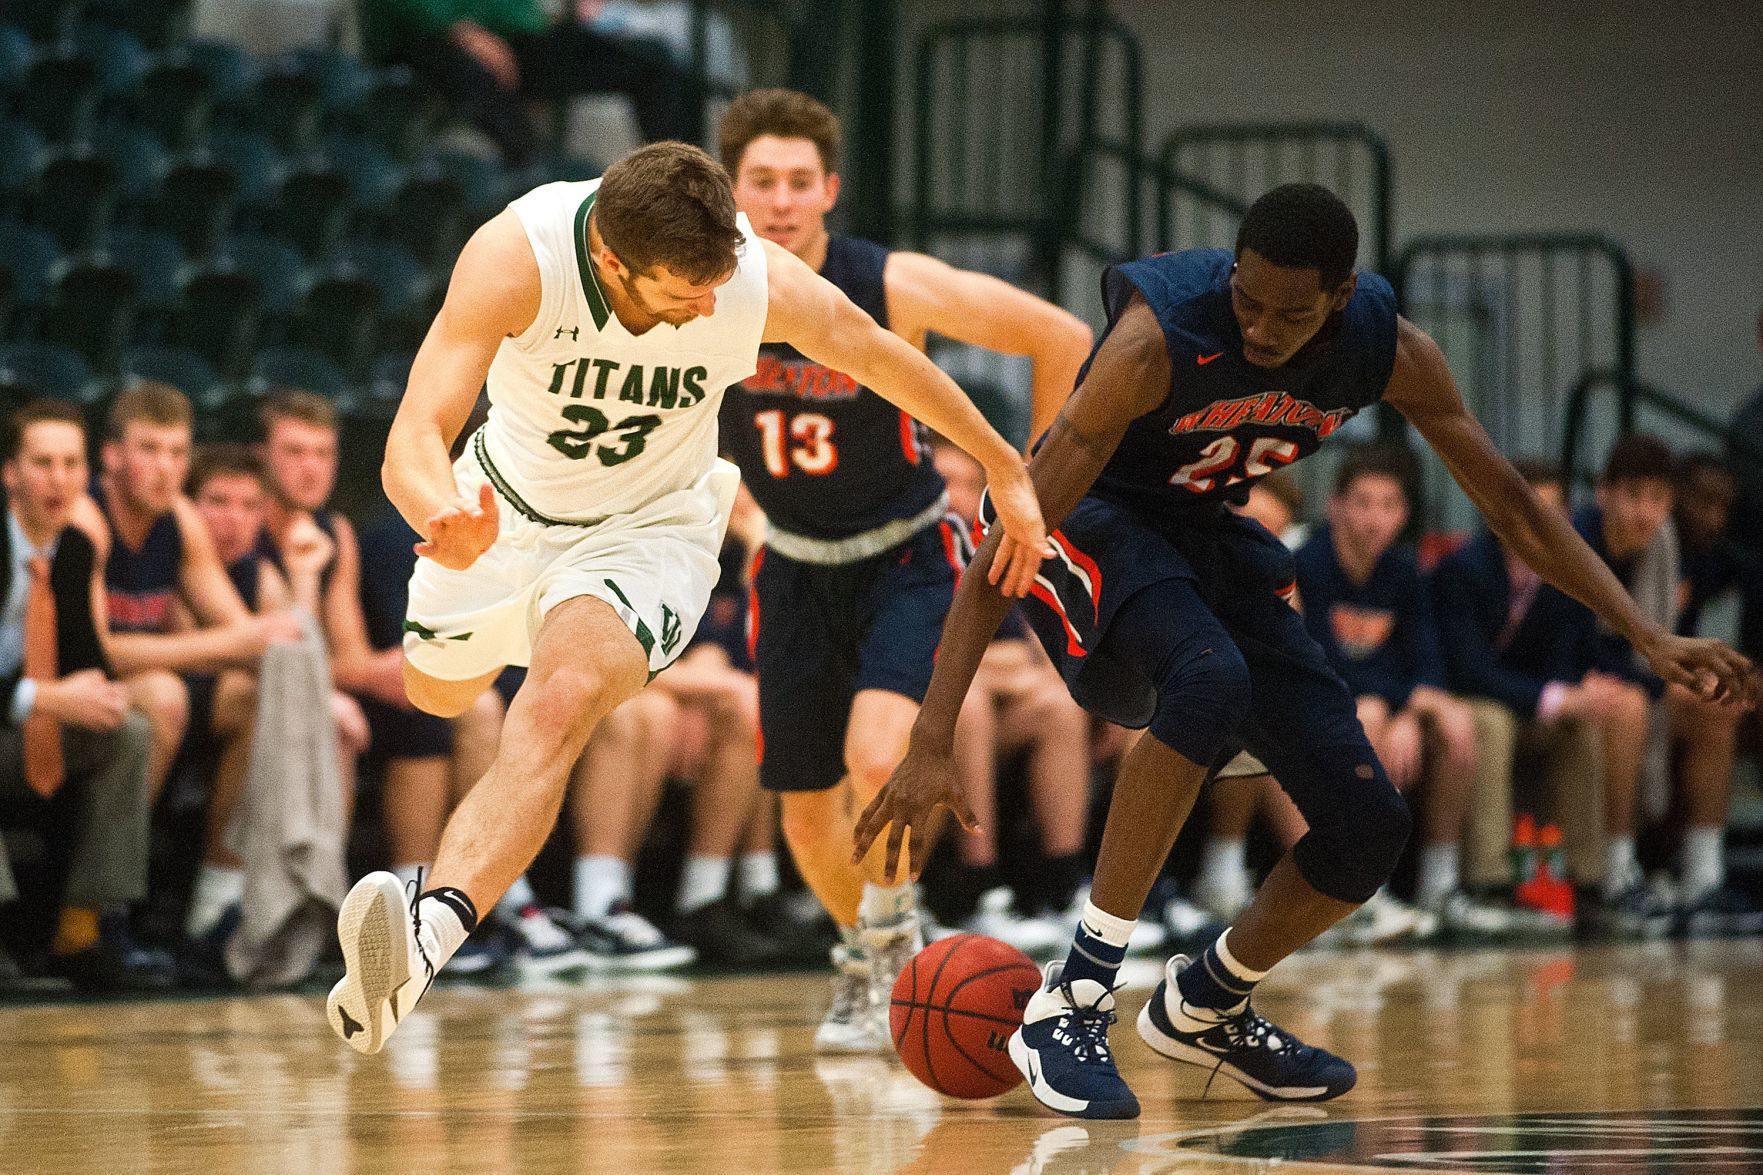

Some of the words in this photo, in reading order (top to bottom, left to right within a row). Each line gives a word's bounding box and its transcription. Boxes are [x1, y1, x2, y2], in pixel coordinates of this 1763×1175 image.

[548, 357, 708, 410] TITANS
[546, 404, 663, 467] 23
[754, 409, 840, 479] 13
[1169, 435, 1300, 493] 25
